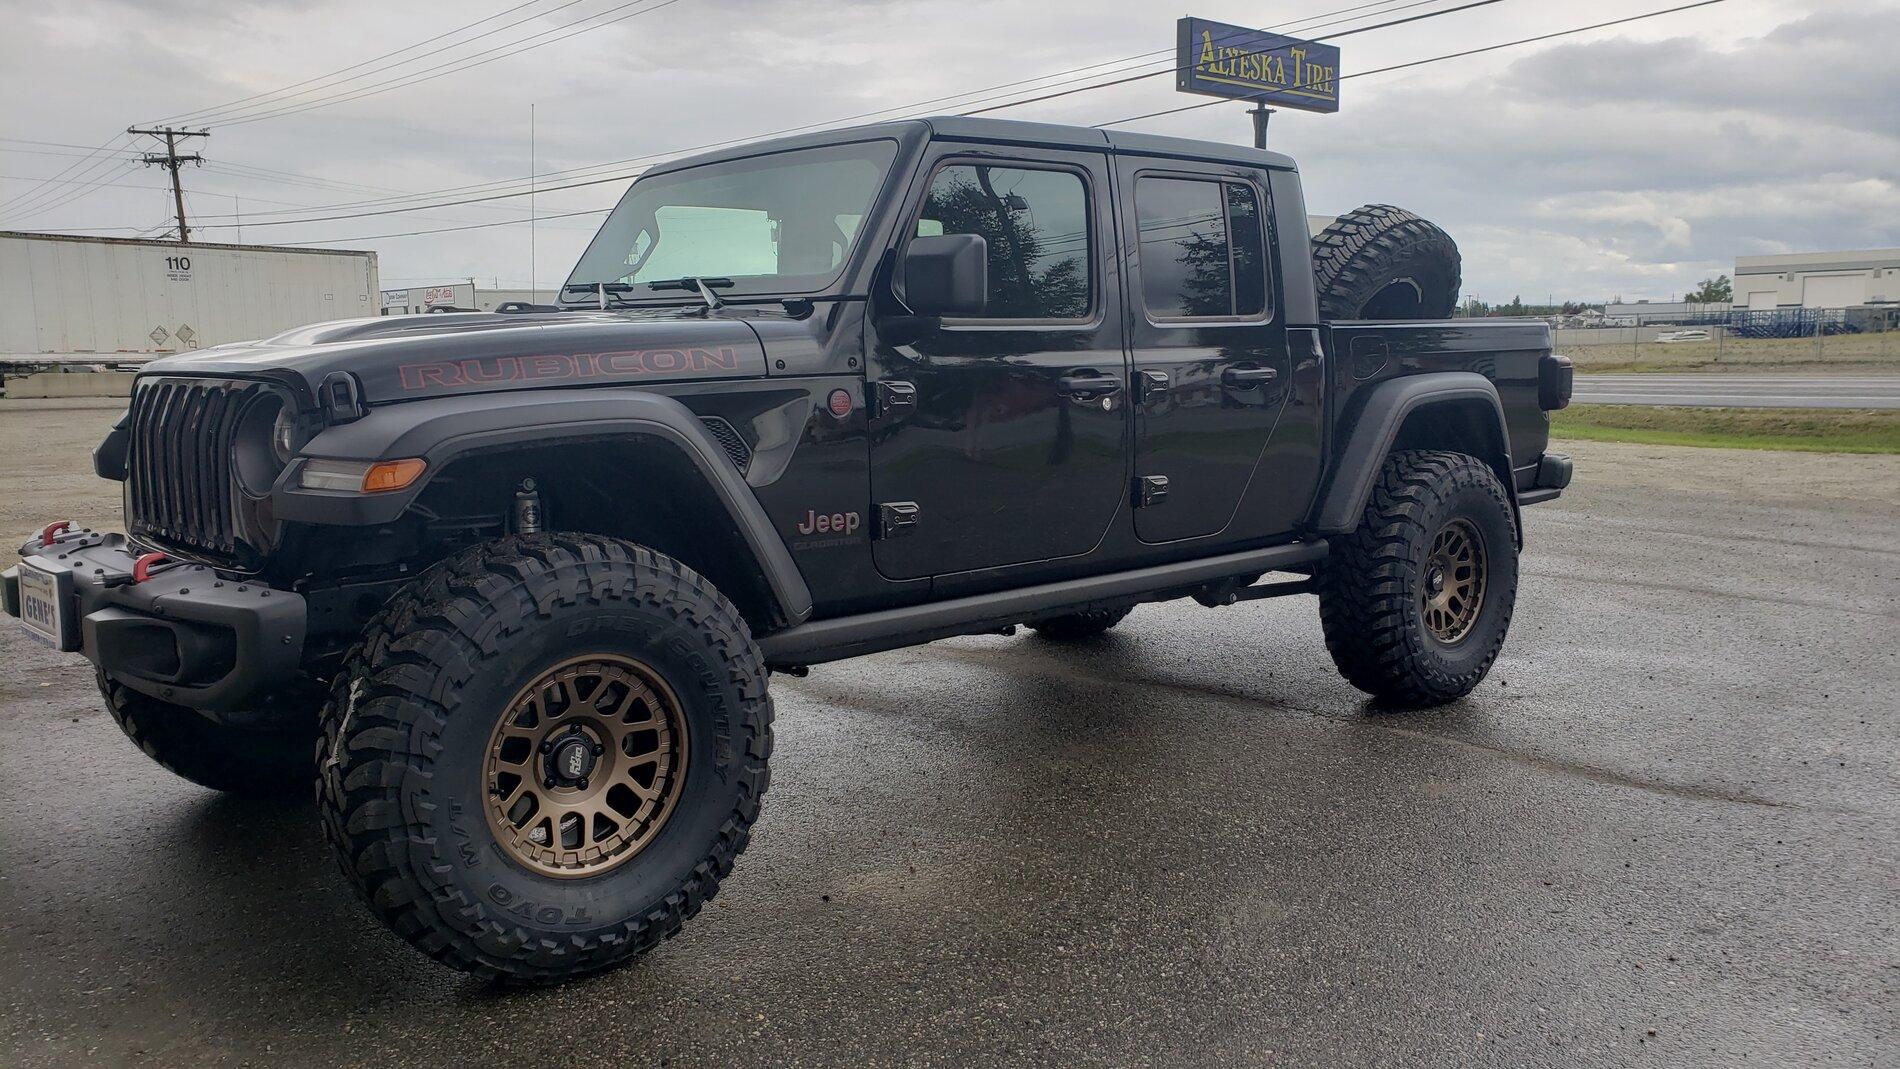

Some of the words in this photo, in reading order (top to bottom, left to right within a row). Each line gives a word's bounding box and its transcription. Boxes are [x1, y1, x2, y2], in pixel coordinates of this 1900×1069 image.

[1196, 30, 1287, 85] ALYESKA
[1291, 46, 1334, 94] TIRE
[165, 256, 191, 270] 110
[399, 347, 737, 390] RUBICON
[797, 510, 860, 535] Jeep
[26, 595, 56, 629] GENE'S
[487, 881, 593, 926] TOYO
